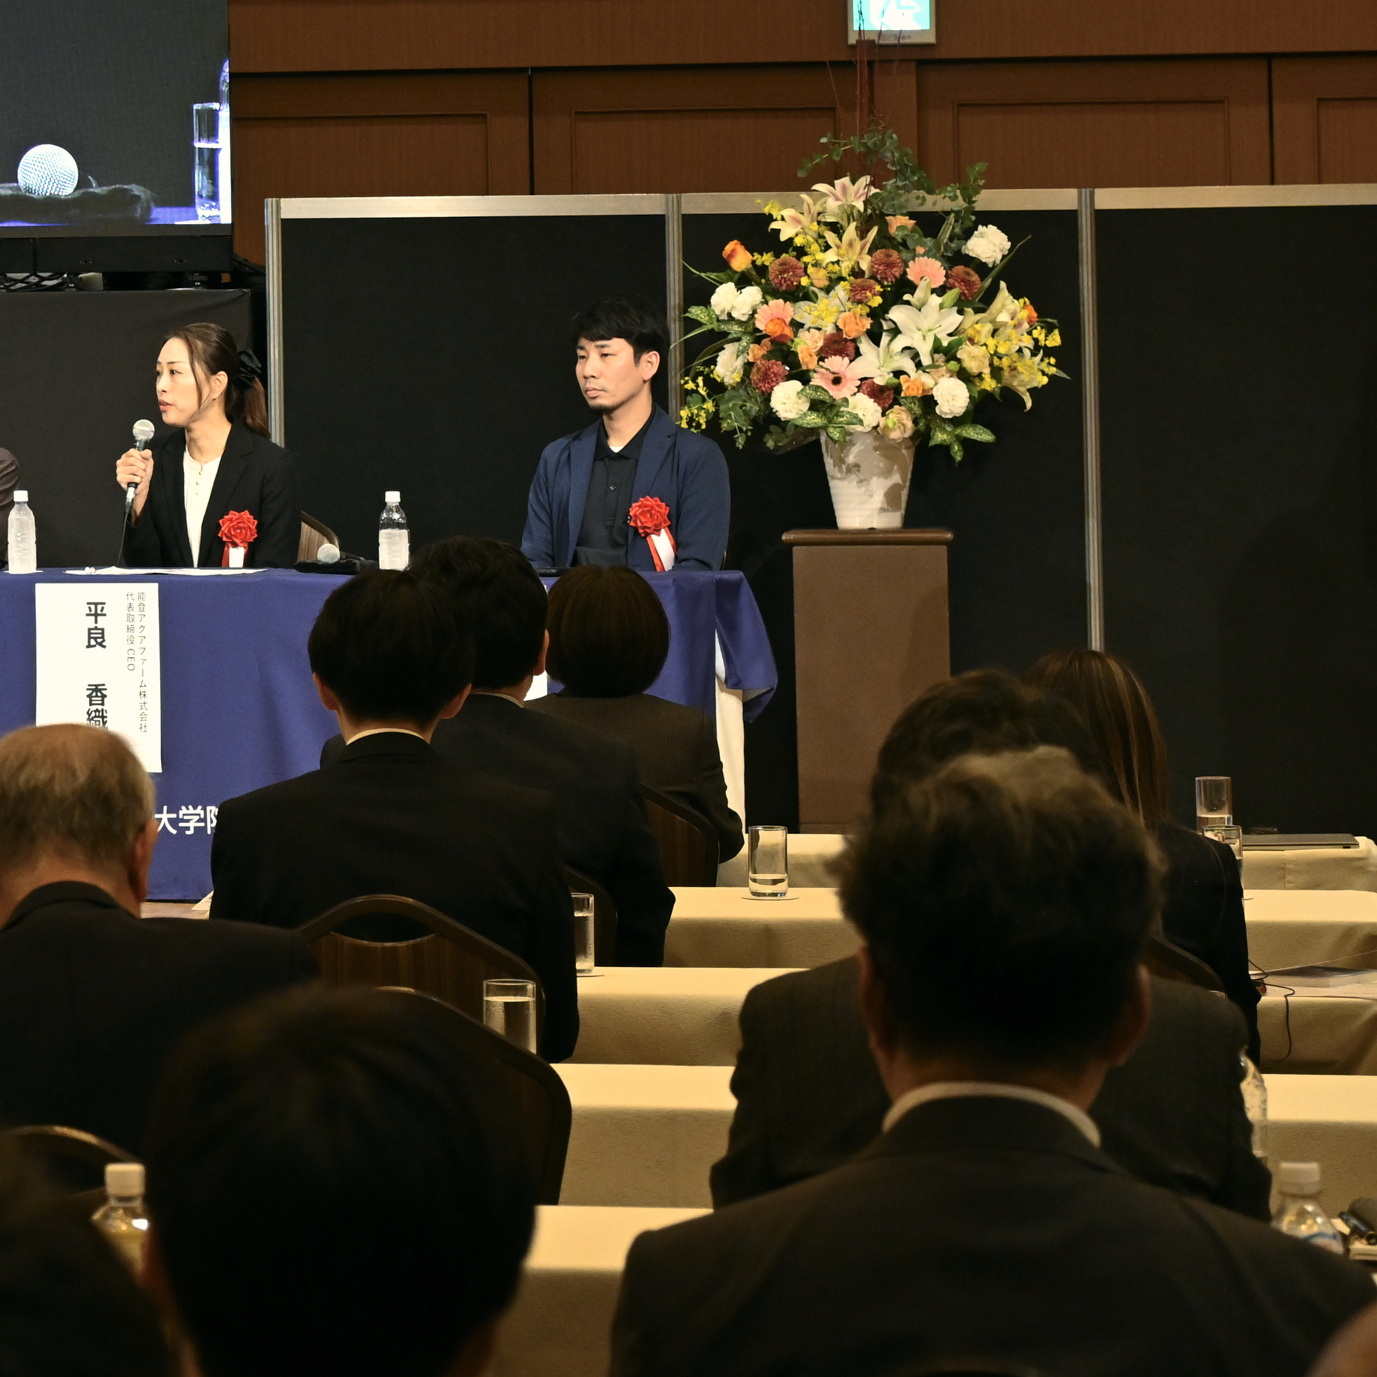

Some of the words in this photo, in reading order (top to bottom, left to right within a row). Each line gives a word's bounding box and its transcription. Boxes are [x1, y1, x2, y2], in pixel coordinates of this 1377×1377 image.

[85, 601, 107, 649] 平良
[126, 591, 136, 645] 代表取締役
[127, 648, 136, 672] CEO
[137, 591, 148, 733] 能登アクアファーム株式会社
